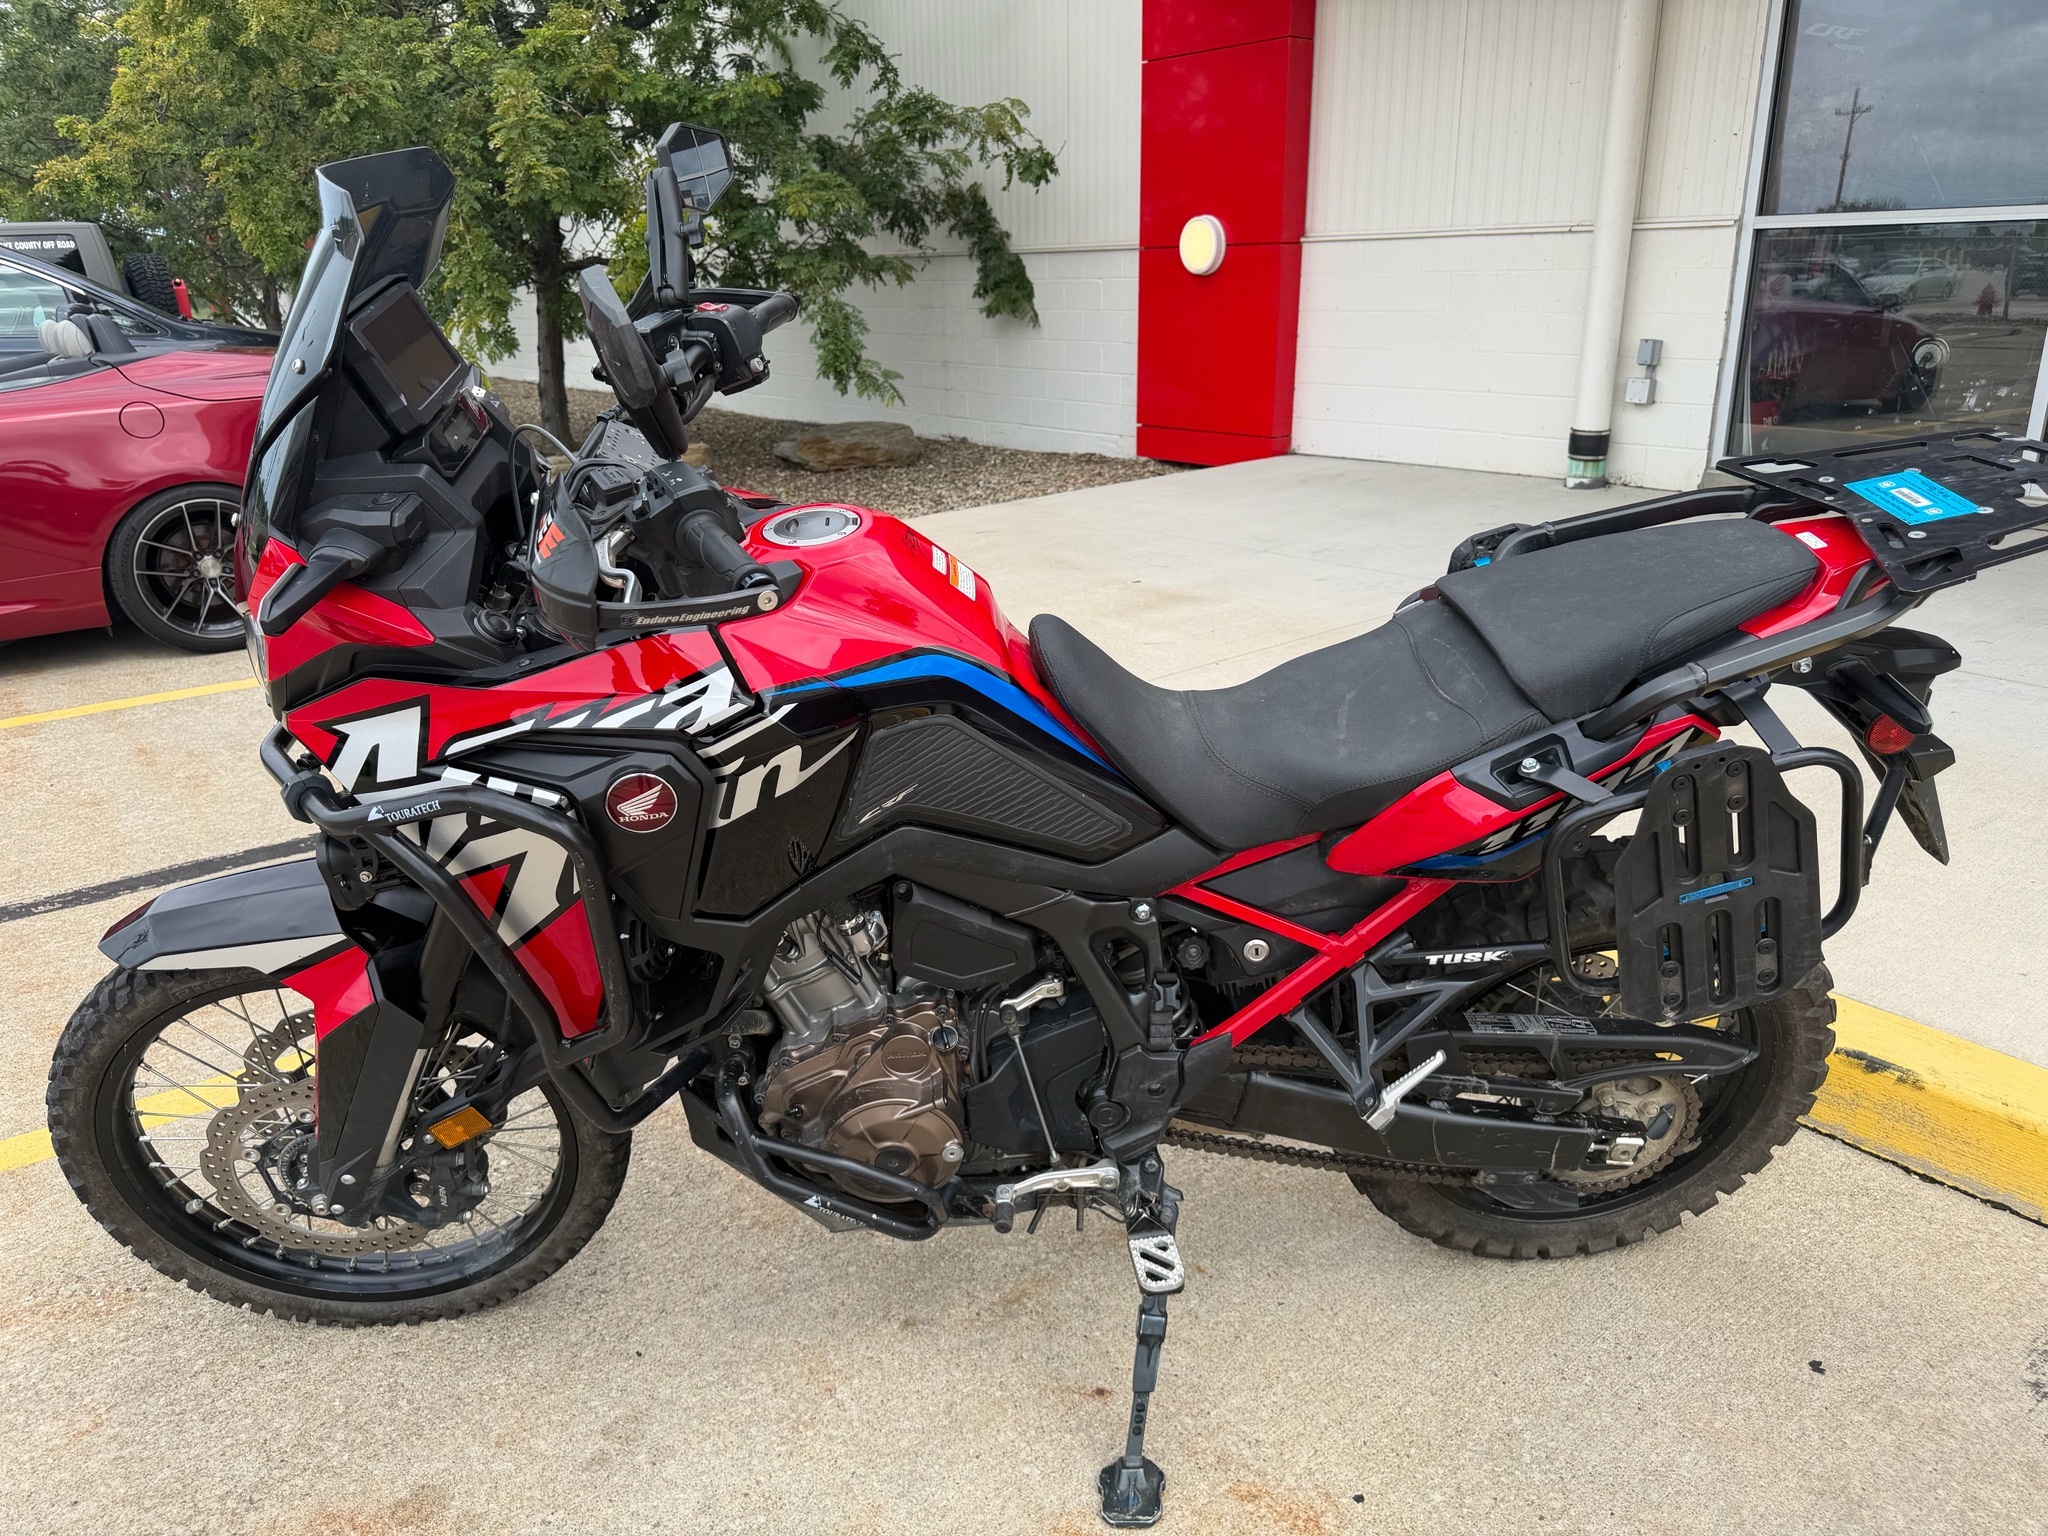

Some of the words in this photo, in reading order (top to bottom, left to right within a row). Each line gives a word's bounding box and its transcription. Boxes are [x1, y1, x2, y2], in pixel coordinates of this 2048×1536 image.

[1804, 22, 1871, 40] CRF
[14, 240, 41, 250] COUNTY
[43, 240, 55, 250] OFF
[56, 240, 76, 249] ROAD
[384, 799, 442, 823] TOURATECH
[858, 783, 919, 824] CRF
[618, 811, 670, 823] HONDA
[1425, 950, 1507, 965] TUSK
